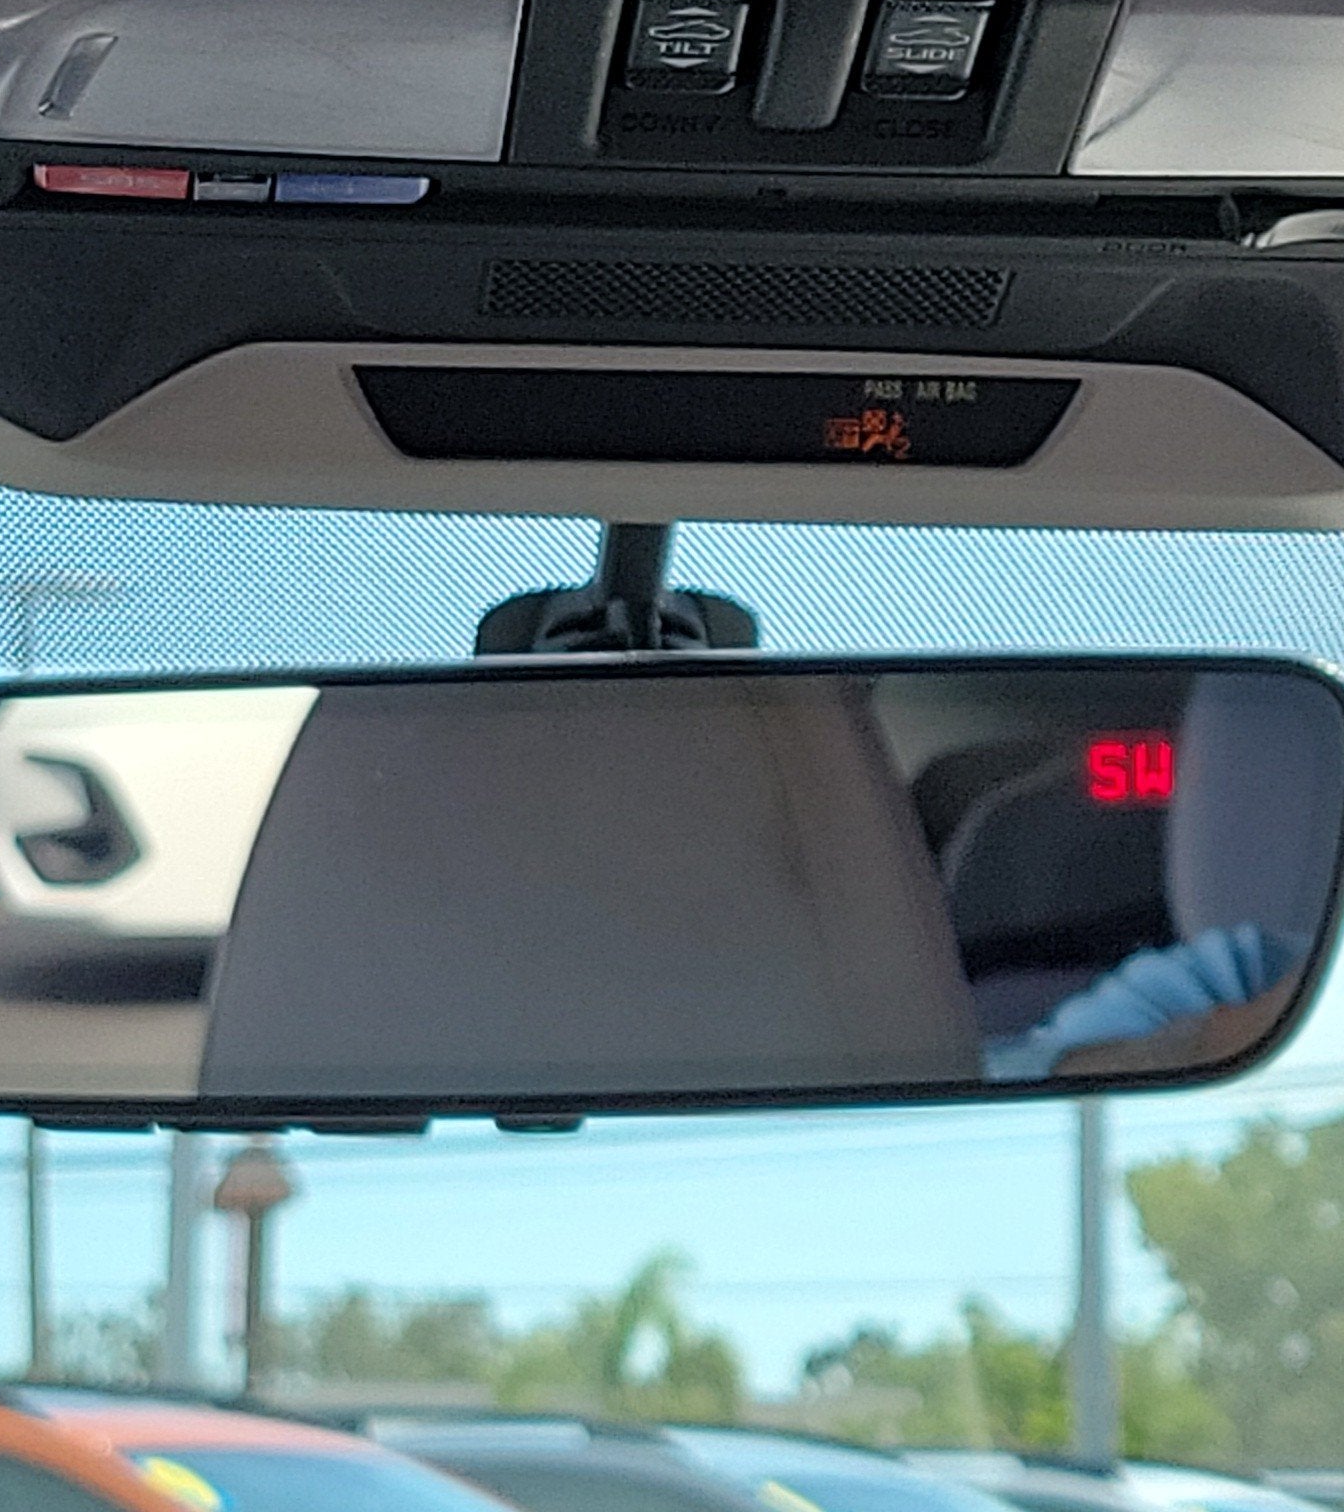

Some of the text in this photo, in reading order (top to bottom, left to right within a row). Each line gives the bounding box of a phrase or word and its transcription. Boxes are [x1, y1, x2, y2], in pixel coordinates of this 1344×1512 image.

[655, 41, 719, 54] TILT
[885, 47, 965, 61] SLIDE
[1088, 740, 1173, 801] SW
